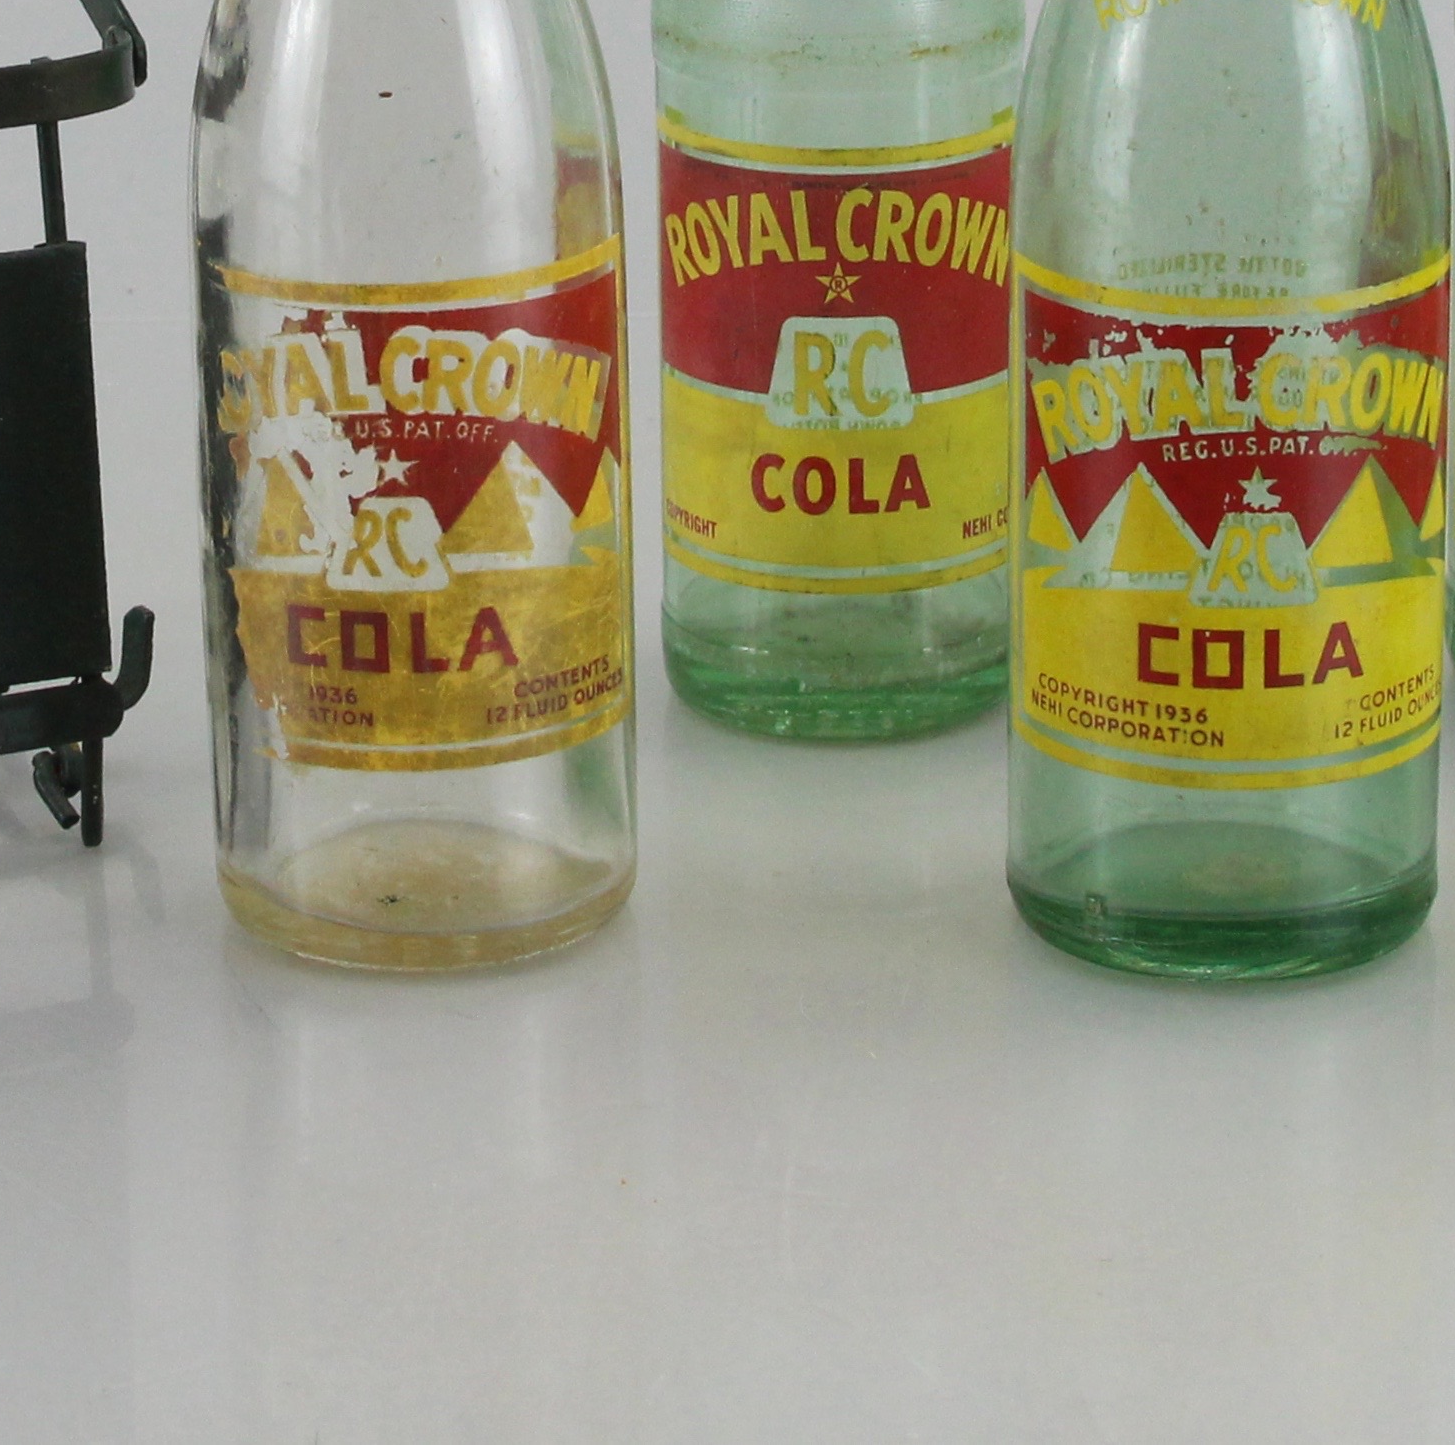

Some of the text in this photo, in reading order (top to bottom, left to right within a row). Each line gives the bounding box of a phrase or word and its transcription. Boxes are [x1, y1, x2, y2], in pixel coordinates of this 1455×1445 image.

[665, 188, 1011, 287] ROYAL CROWN
[379, 336, 601, 434] CROWN
[793, 330, 892, 417] RC
[1032, 352, 1443, 454] ROYAL CROWN
[750, 453, 931, 516] COLA
[343, 506, 429, 578] RC
[1208, 526, 1297, 592] RC
[287, 607, 519, 673] COLA
[1137, 621, 1363, 689] COLA
[309, 685, 357, 705] 1936
[514, 654, 609, 698] CONTENTS
[1038, 672, 1208, 725] COPYRIGHT 1936
[1359, 664, 1434, 712] CONTENTS
[487, 707, 506, 725] 12
[513, 694, 567, 722] FLUID
[1031, 691, 1224, 748] NEHI CORPORATION
[1334, 723, 1353, 739] 12
[1360, 709, 1402, 734] FLUID
